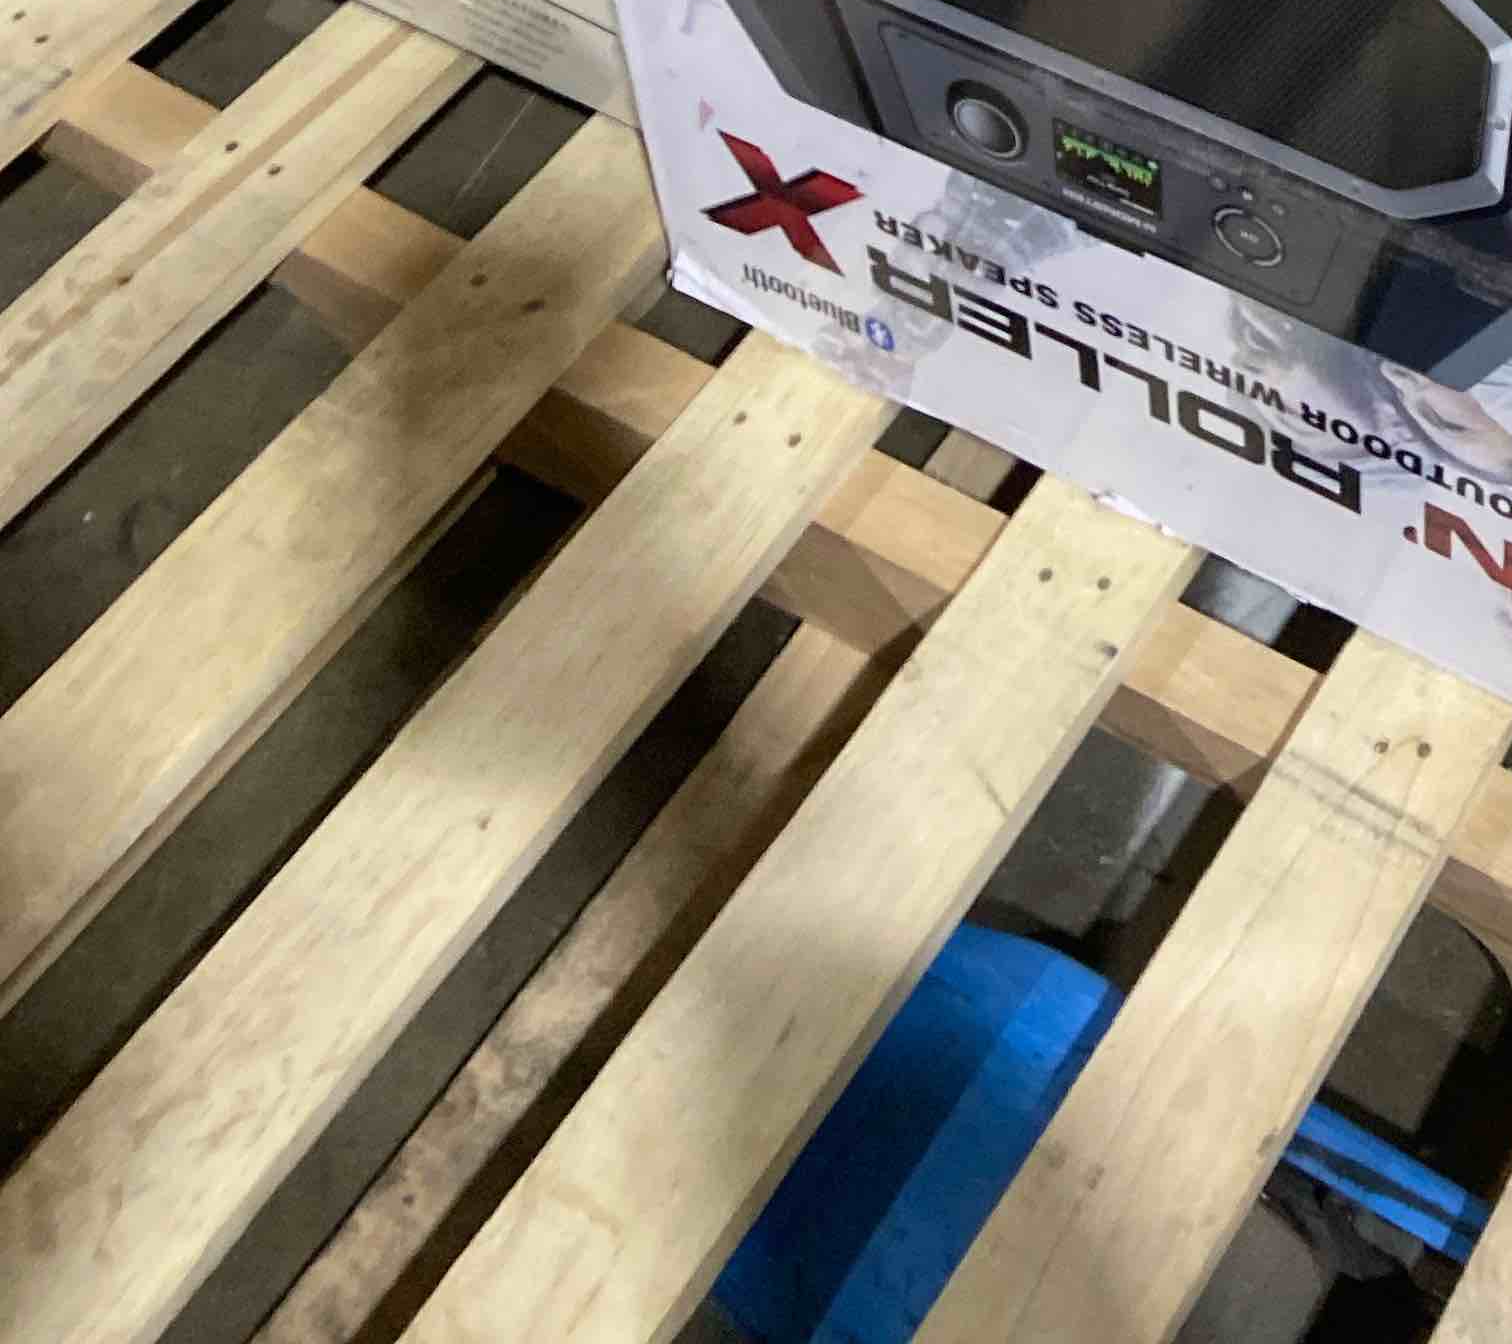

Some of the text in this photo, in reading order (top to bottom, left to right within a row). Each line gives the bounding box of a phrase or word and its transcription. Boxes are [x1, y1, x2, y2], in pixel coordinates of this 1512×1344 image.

[701, 128, 864, 276] X
[742, 262, 861, 338] Bluetooth
[873, 209, 1058, 311] SPEAKER
[867, 245, 1362, 515] ROLLER
[1075, 305, 1283, 411] WIRELESS
